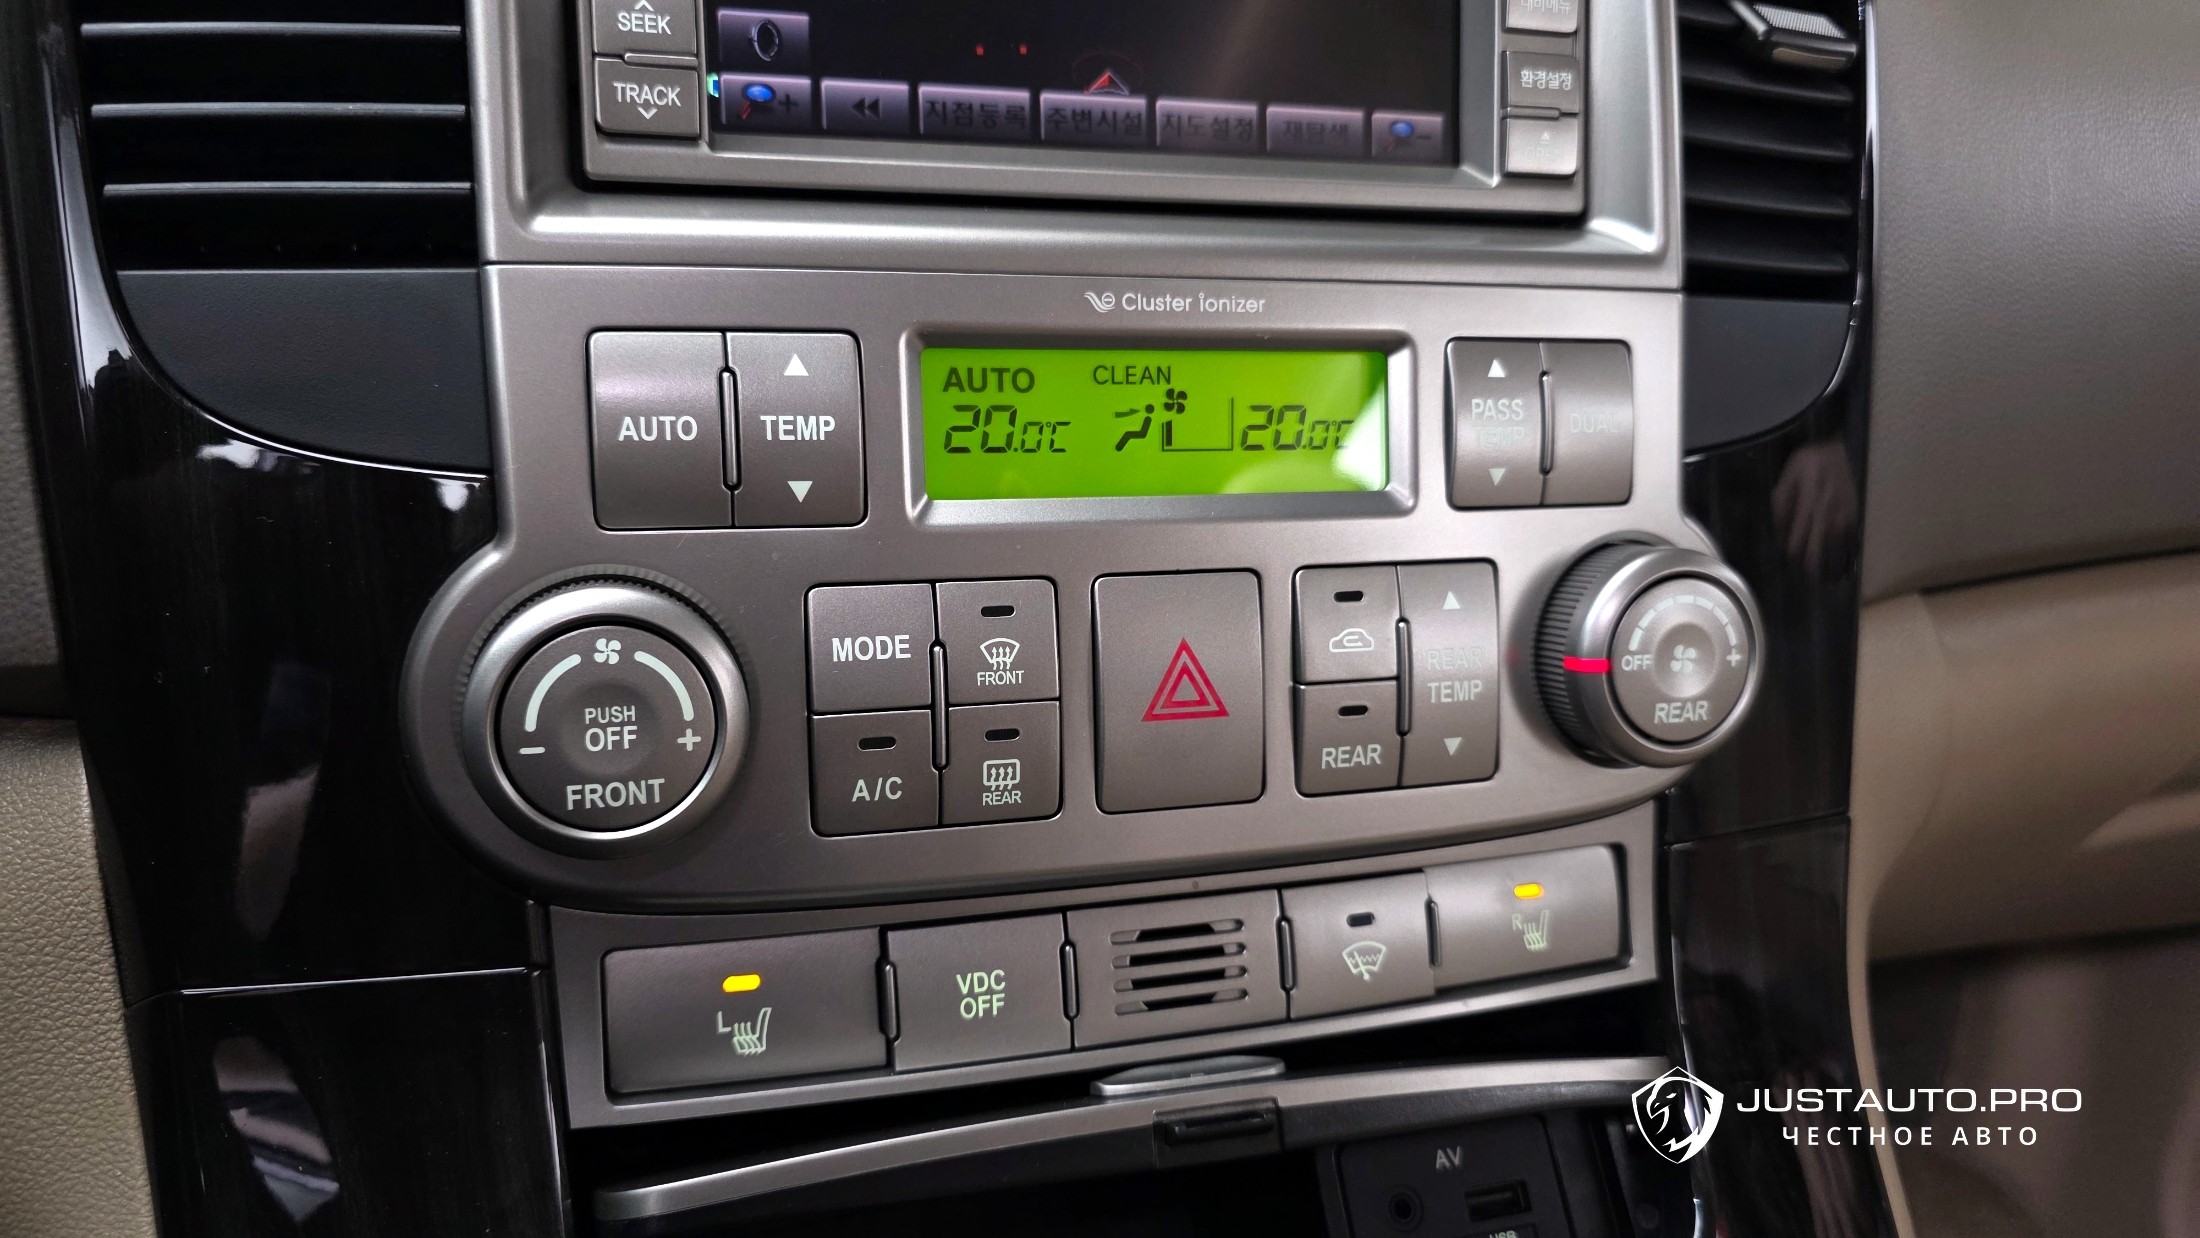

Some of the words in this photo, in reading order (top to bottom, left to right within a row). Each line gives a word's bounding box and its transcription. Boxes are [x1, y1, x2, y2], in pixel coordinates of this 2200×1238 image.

[617, 12, 672, 36] SEEK
[1520, 69, 1572, 91] 환경설정
[613, 82, 682, 108] TRACK
[925, 100, 1027, 130] 지점등록
[1046, 106, 1143, 136] 주변시설
[1161, 113, 1254, 141] 지도설정
[1121, 292, 1193, 312] Cluster
[942, 367, 1036, 393] AUTO
[1092, 364, 1172, 386] CLEAN
[1471, 398, 1524, 421] PASS
[618, 415, 698, 442] AUTO
[760, 415, 836, 441] TEMP
[1569, 411, 1620, 433] DUAL
[1472, 426, 1525, 448] TEMP
[832, 634, 912, 662] MODE
[1427, 647, 1483, 671] REAR
[1621, 655, 1652, 671] OFF
[977, 670, 1025, 686] FRONT
[1427, 679, 1482, 703] TEMP
[584, 705, 636, 724] PUSH
[1653, 701, 1709, 724] REAR
[585, 725, 638, 752] OFF
[1321, 743, 1382, 769] REAR
[566, 778, 666, 811] FRONT
[851, 776, 903, 802] A/C
[982, 790, 1022, 806] REAR
[1511, 913, 1523, 931] R
[956, 969, 1006, 995] VDC
[959, 993, 1006, 1020] OFF
[716, 1010, 732, 1034] L
[1435, 1146, 1463, 1170] AV
